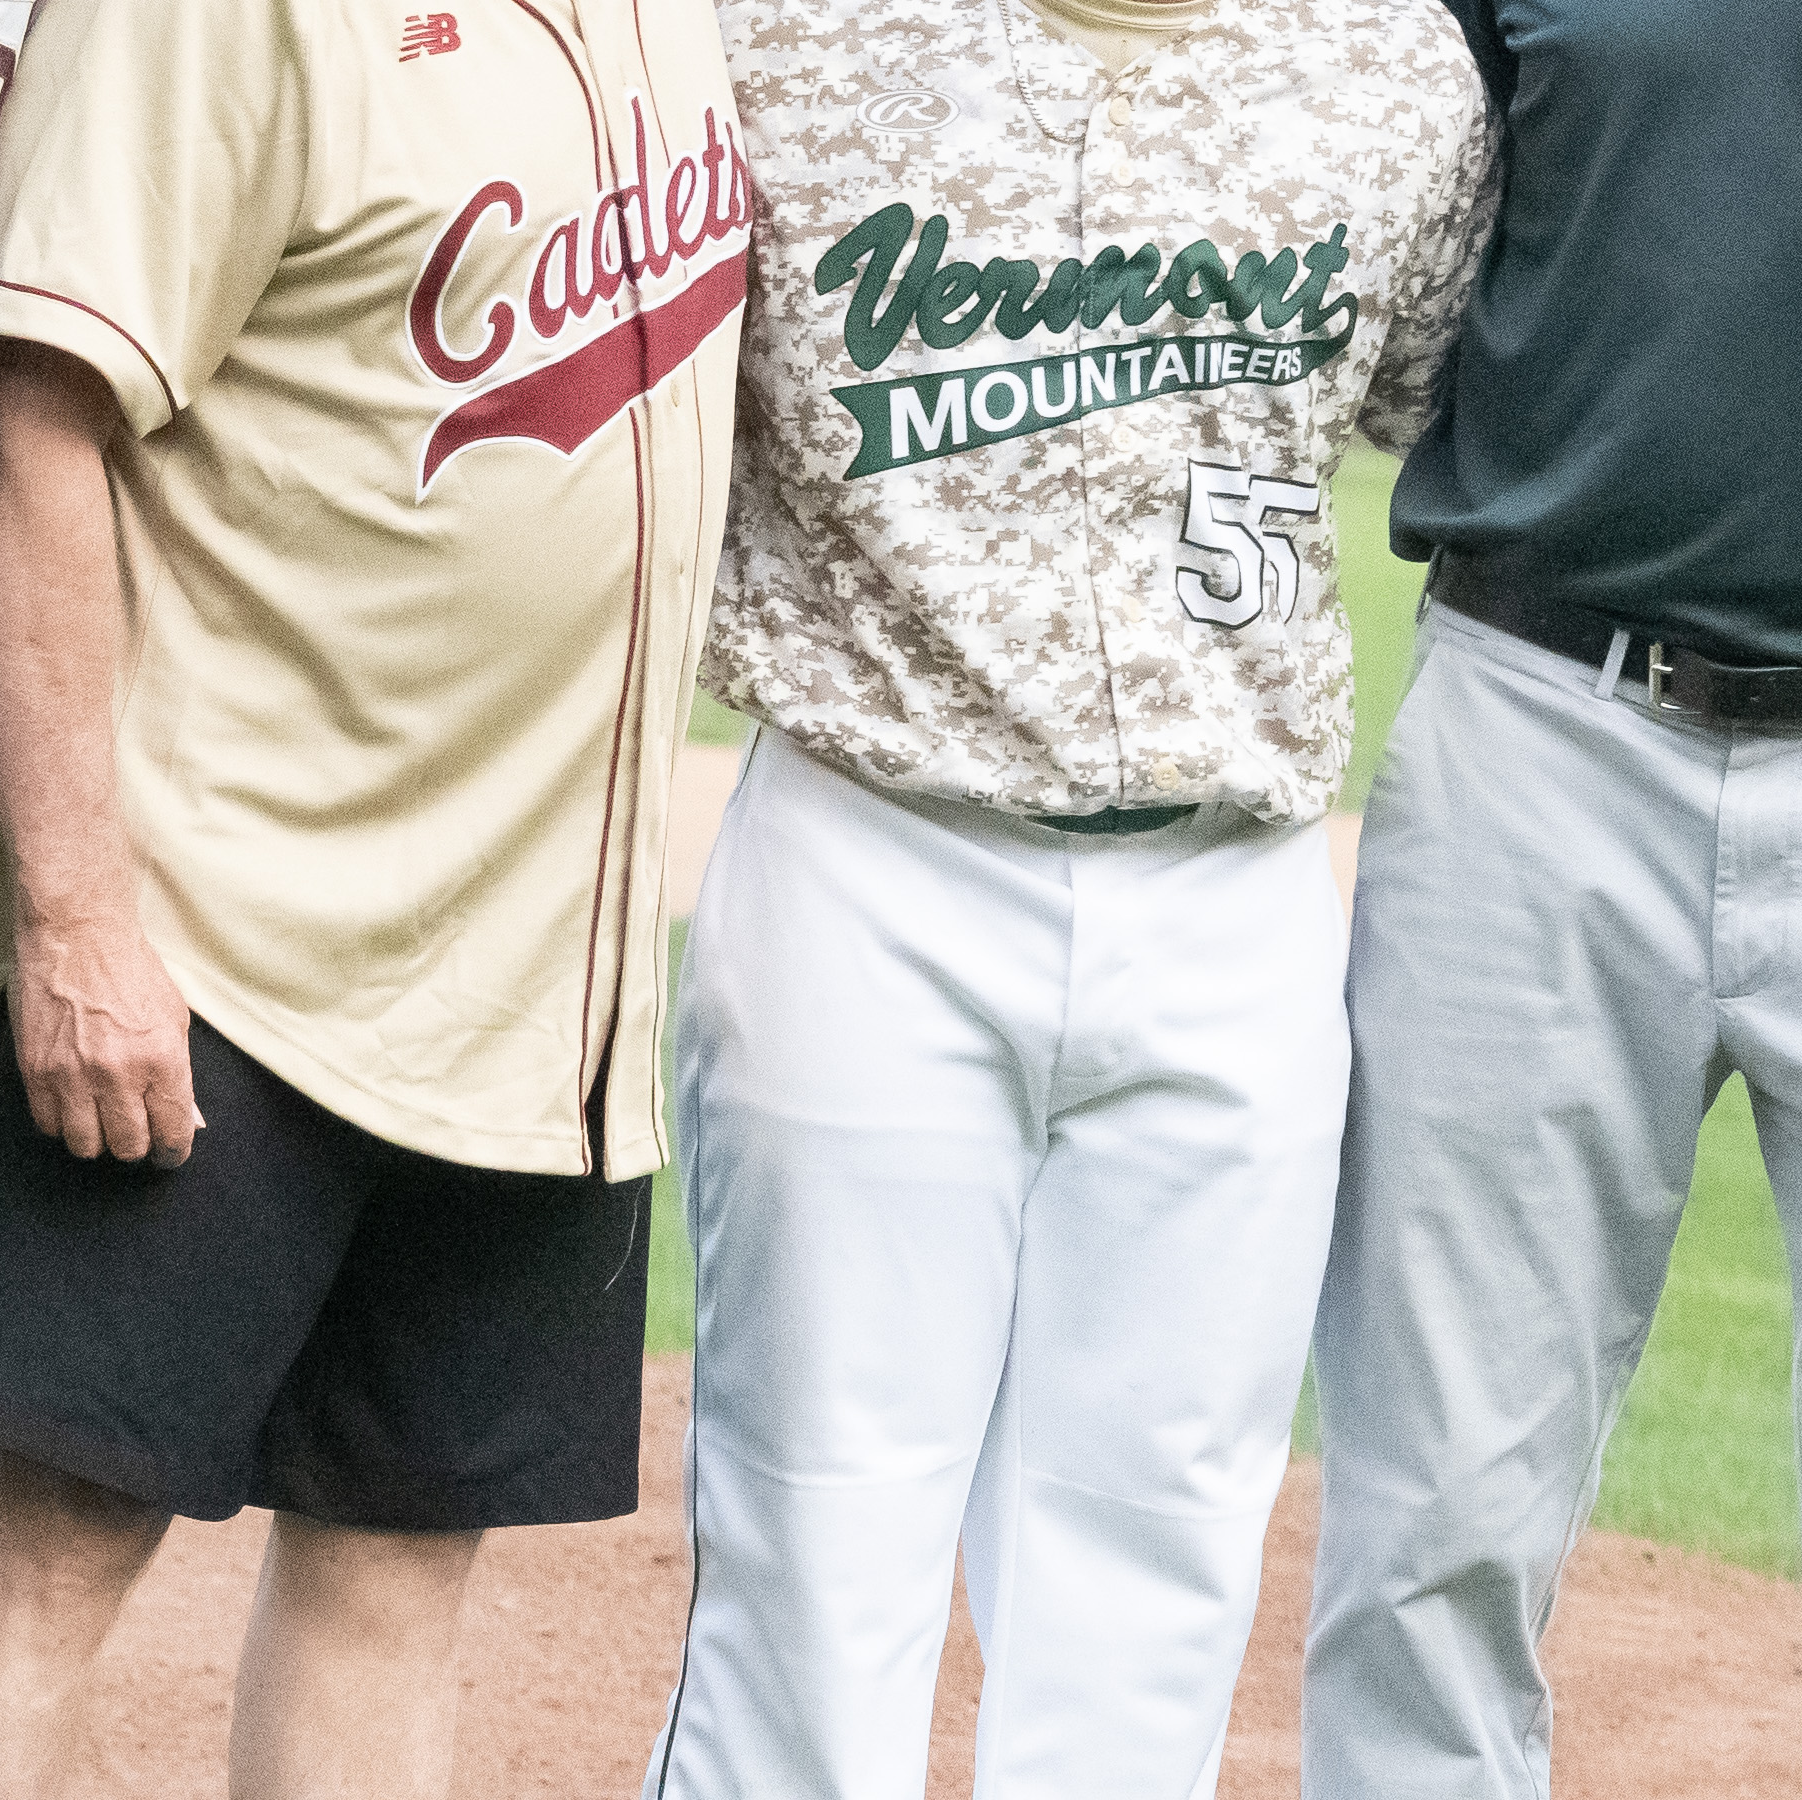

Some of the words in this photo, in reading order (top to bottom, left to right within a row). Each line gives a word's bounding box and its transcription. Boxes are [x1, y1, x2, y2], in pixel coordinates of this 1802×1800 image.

[409, 94, 753, 384] Cadets
[814, 202, 1357, 372] Vermont
[1175, 458, 1320, 631] 55
